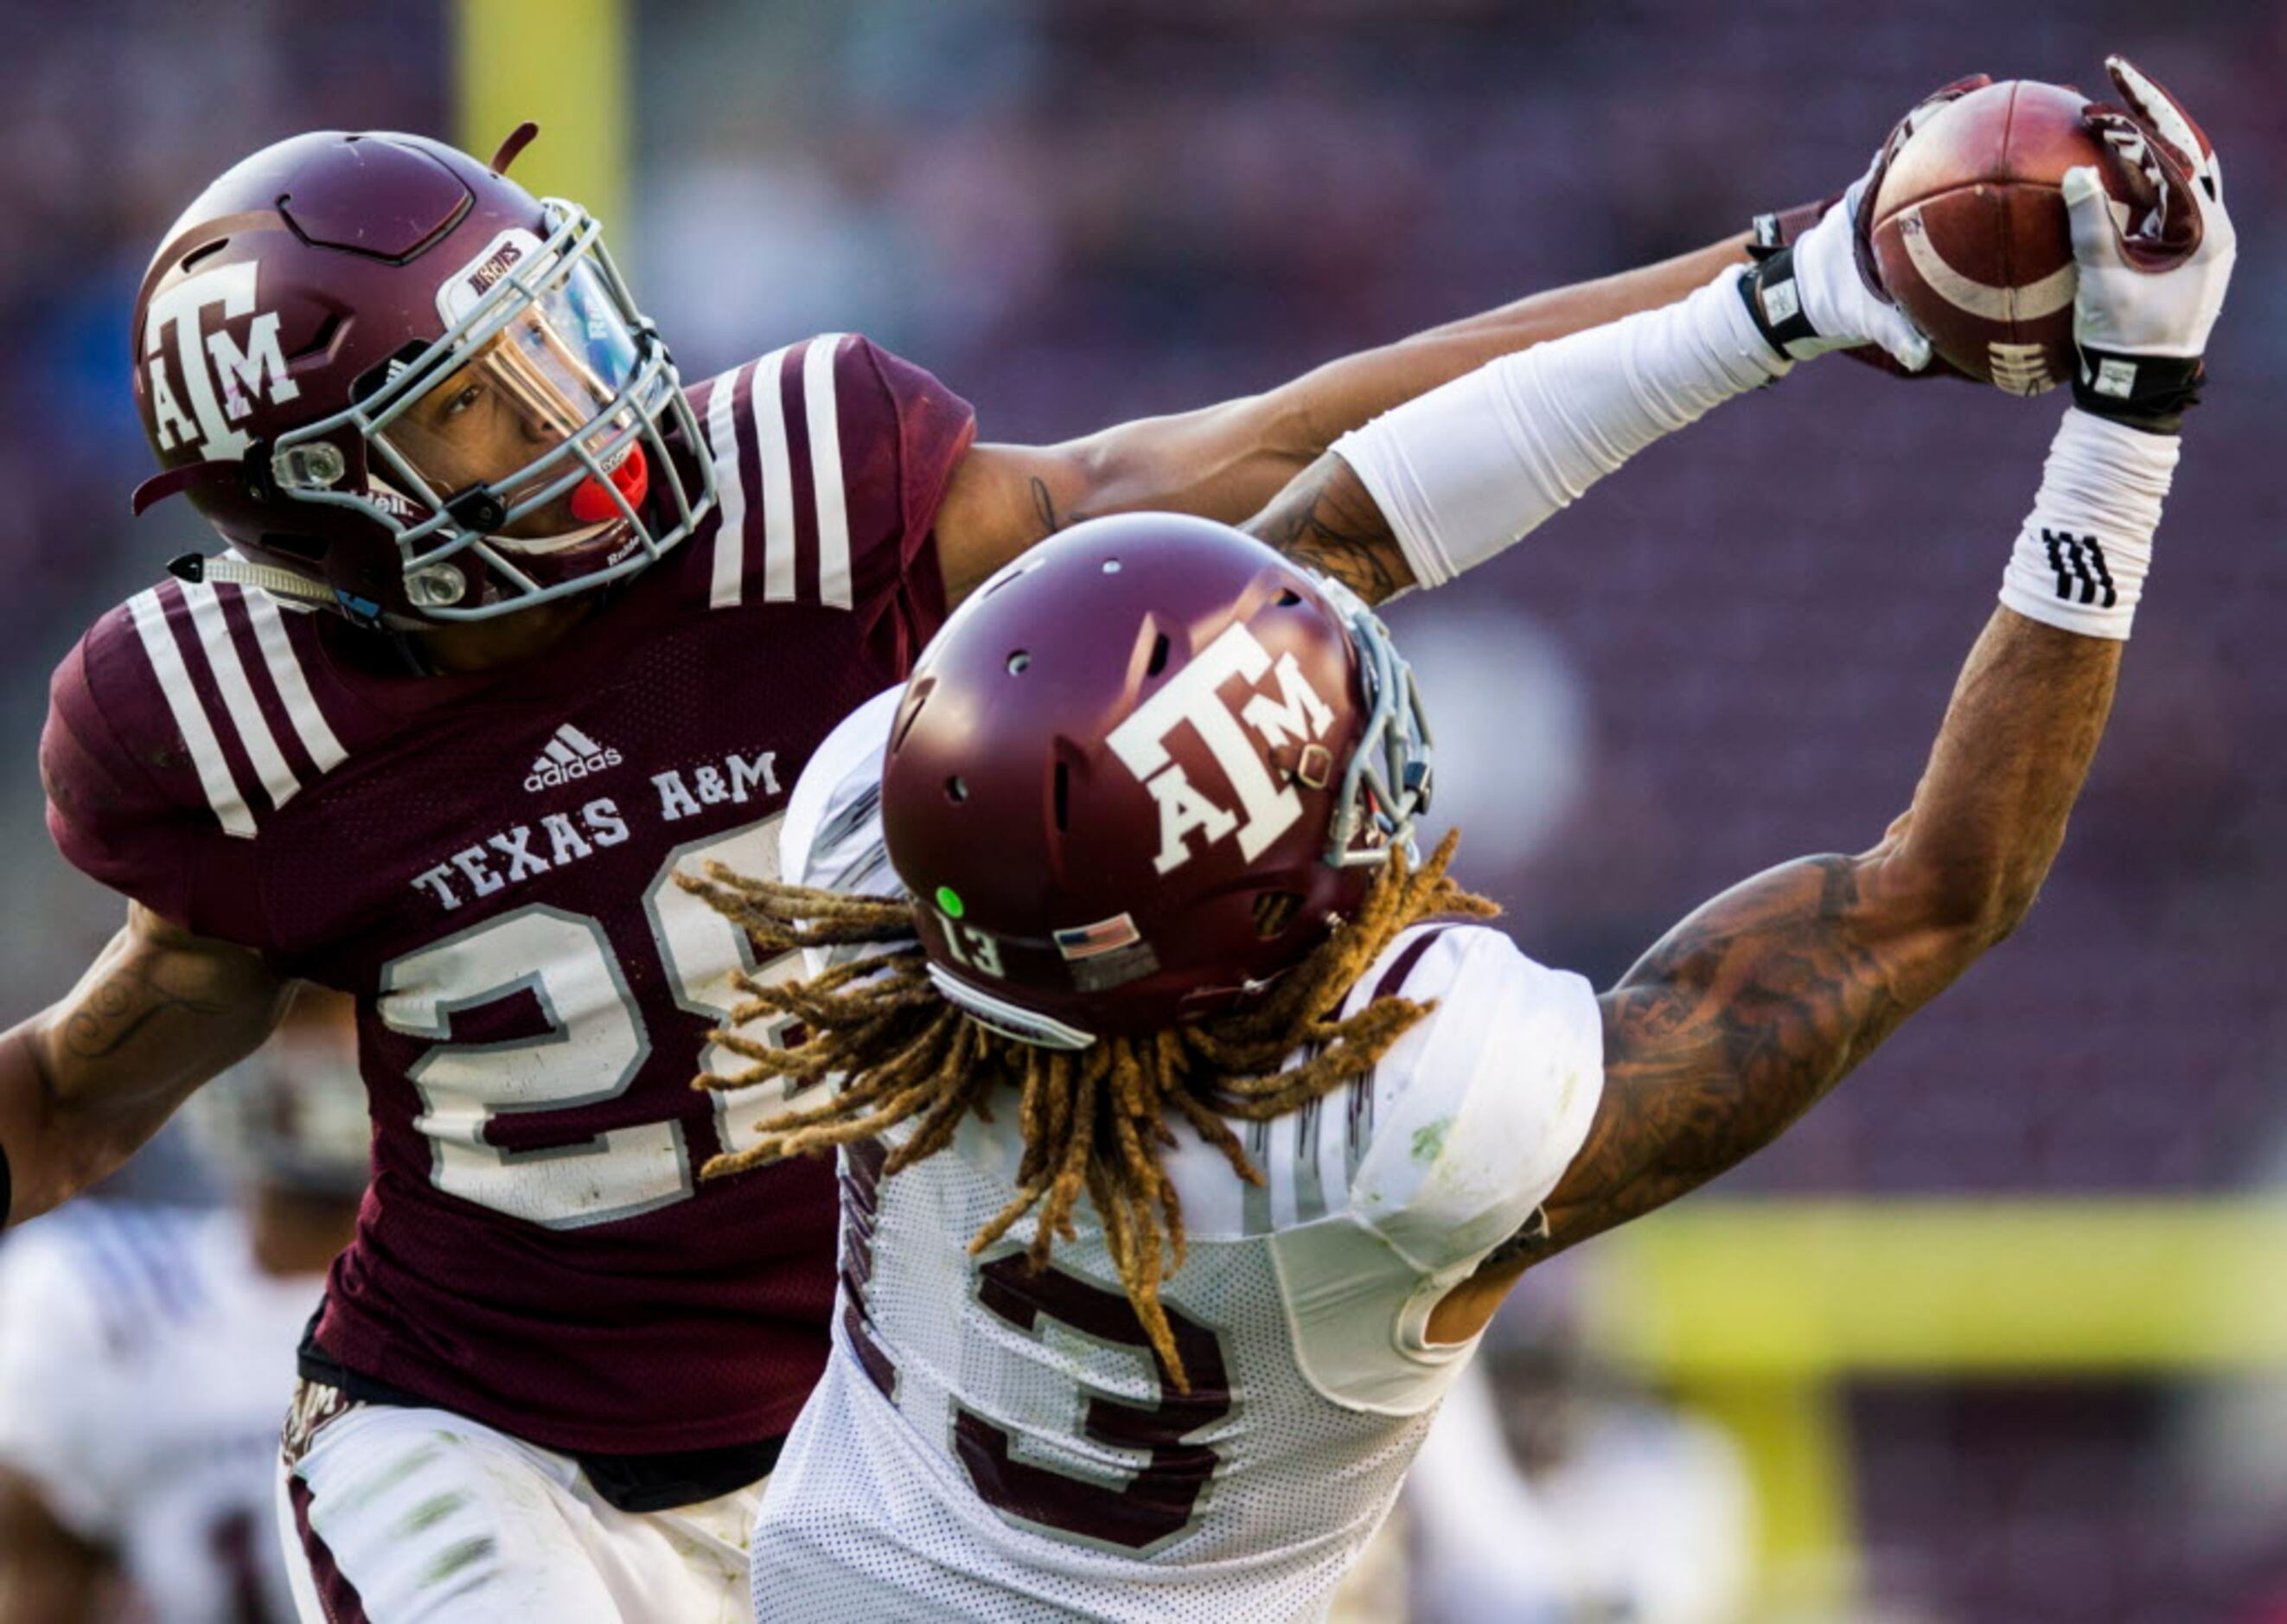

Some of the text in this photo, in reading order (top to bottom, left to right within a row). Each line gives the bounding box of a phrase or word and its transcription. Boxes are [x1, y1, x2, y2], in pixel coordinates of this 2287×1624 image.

[468, 240, 522, 297] AGGIES
[523, 745, 623, 793] adidas
[411, 750, 782, 911] TEXAS A&M
[932, 908, 1006, 979] 13
